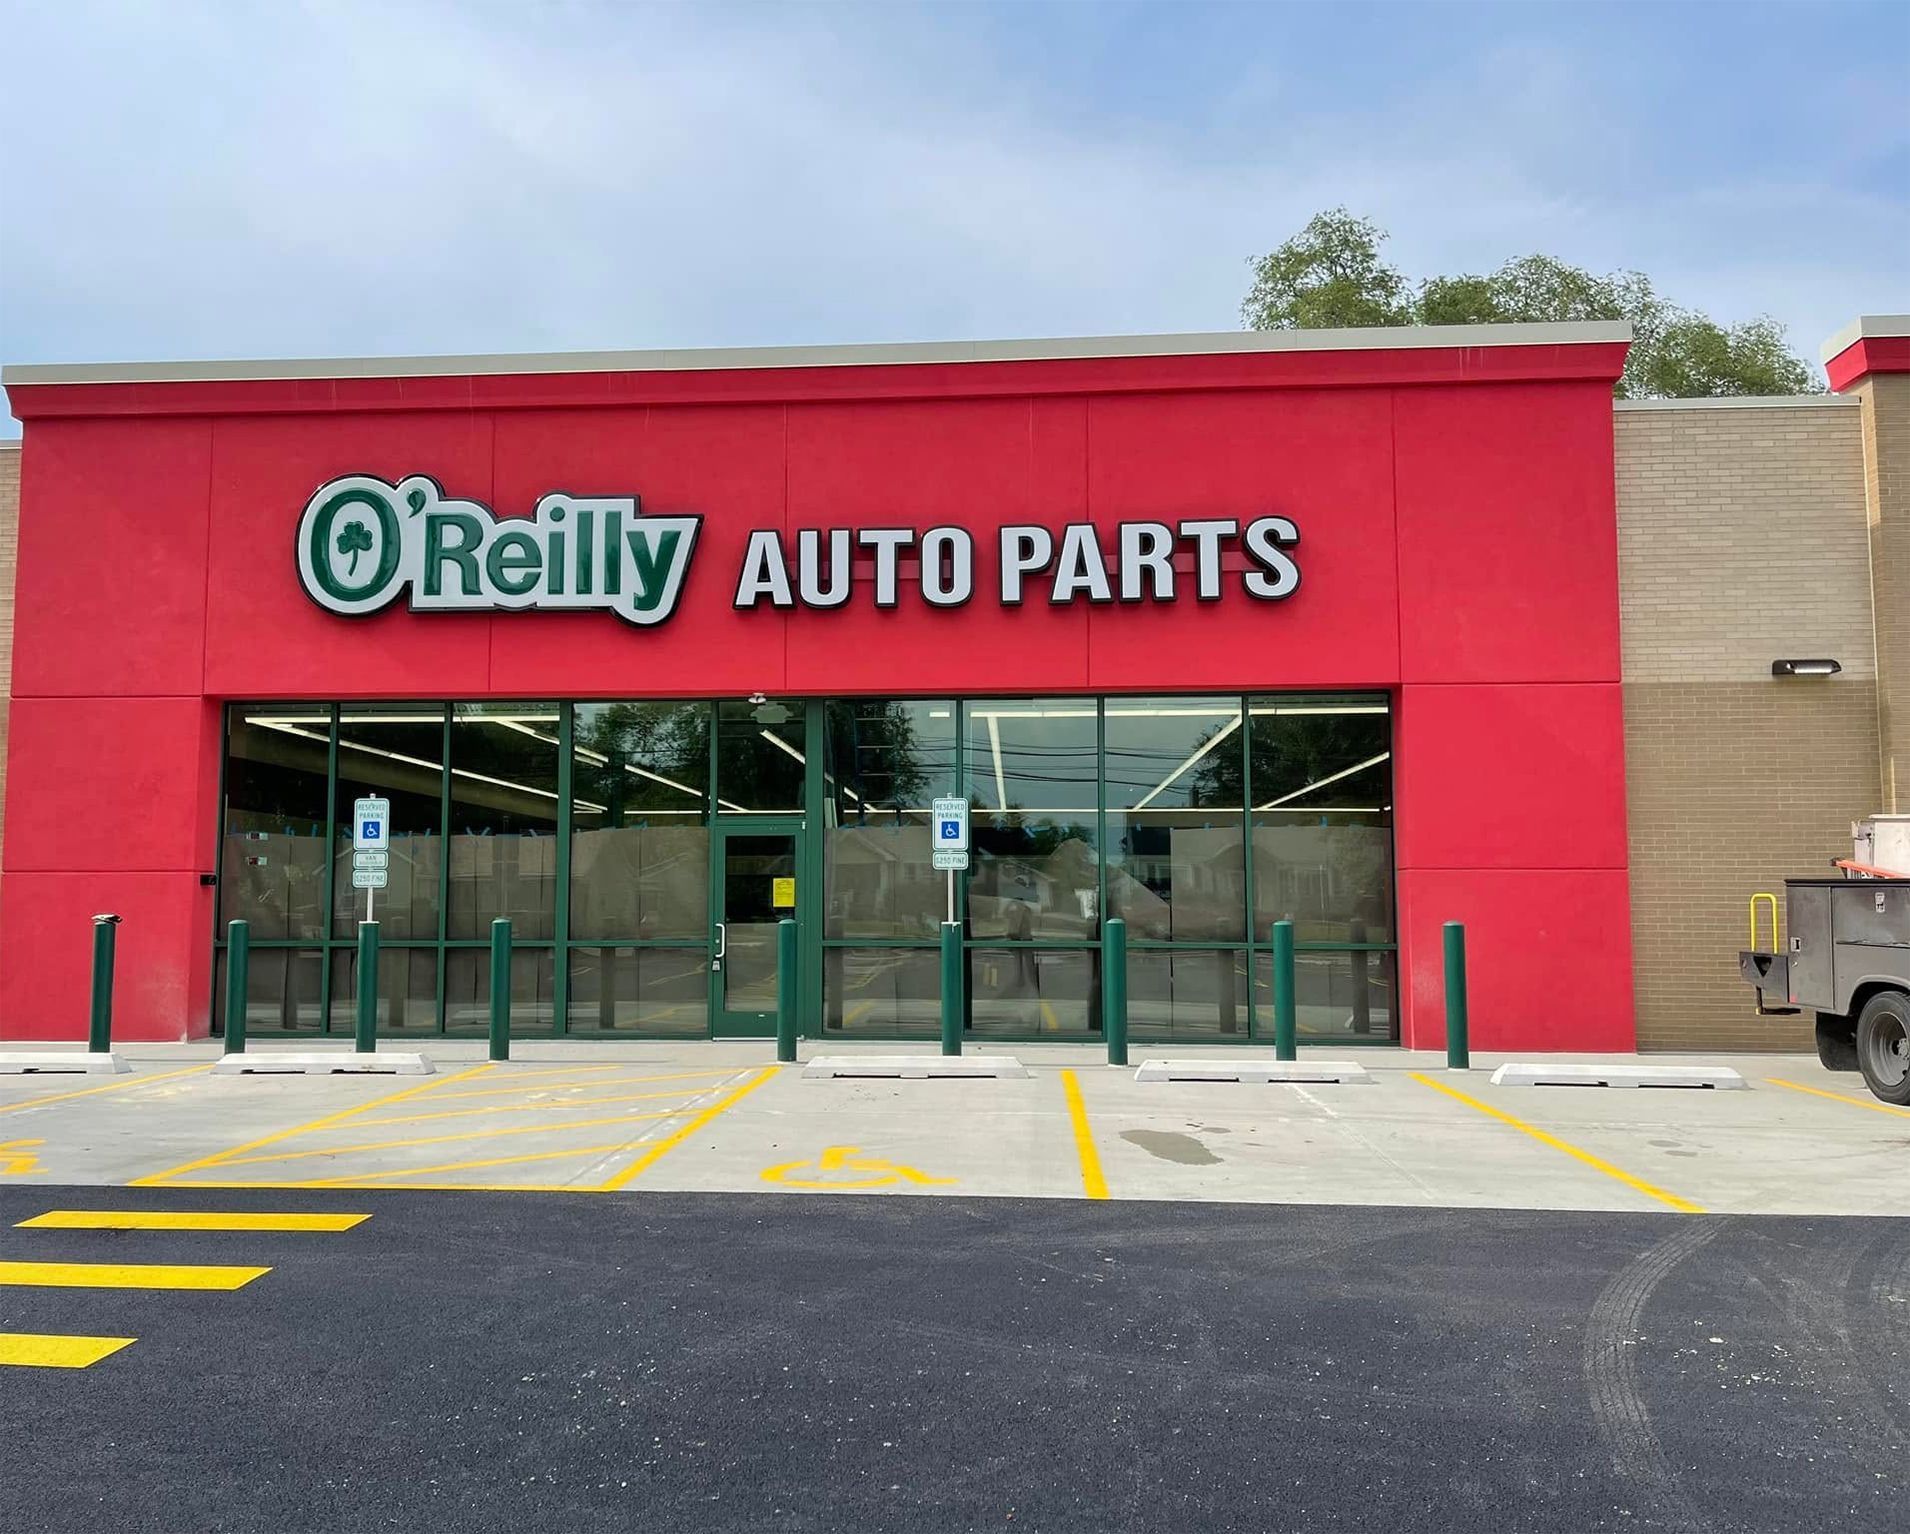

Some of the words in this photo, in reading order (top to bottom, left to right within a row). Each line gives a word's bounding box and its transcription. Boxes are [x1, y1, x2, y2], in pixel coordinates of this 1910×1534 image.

[310, 488, 682, 611] O'Reilly
[734, 526, 974, 606] AUTO
[1000, 517, 1300, 603] PARTS
[358, 803, 385, 811] RESERVED
[952, 856, 965, 864] FINE
